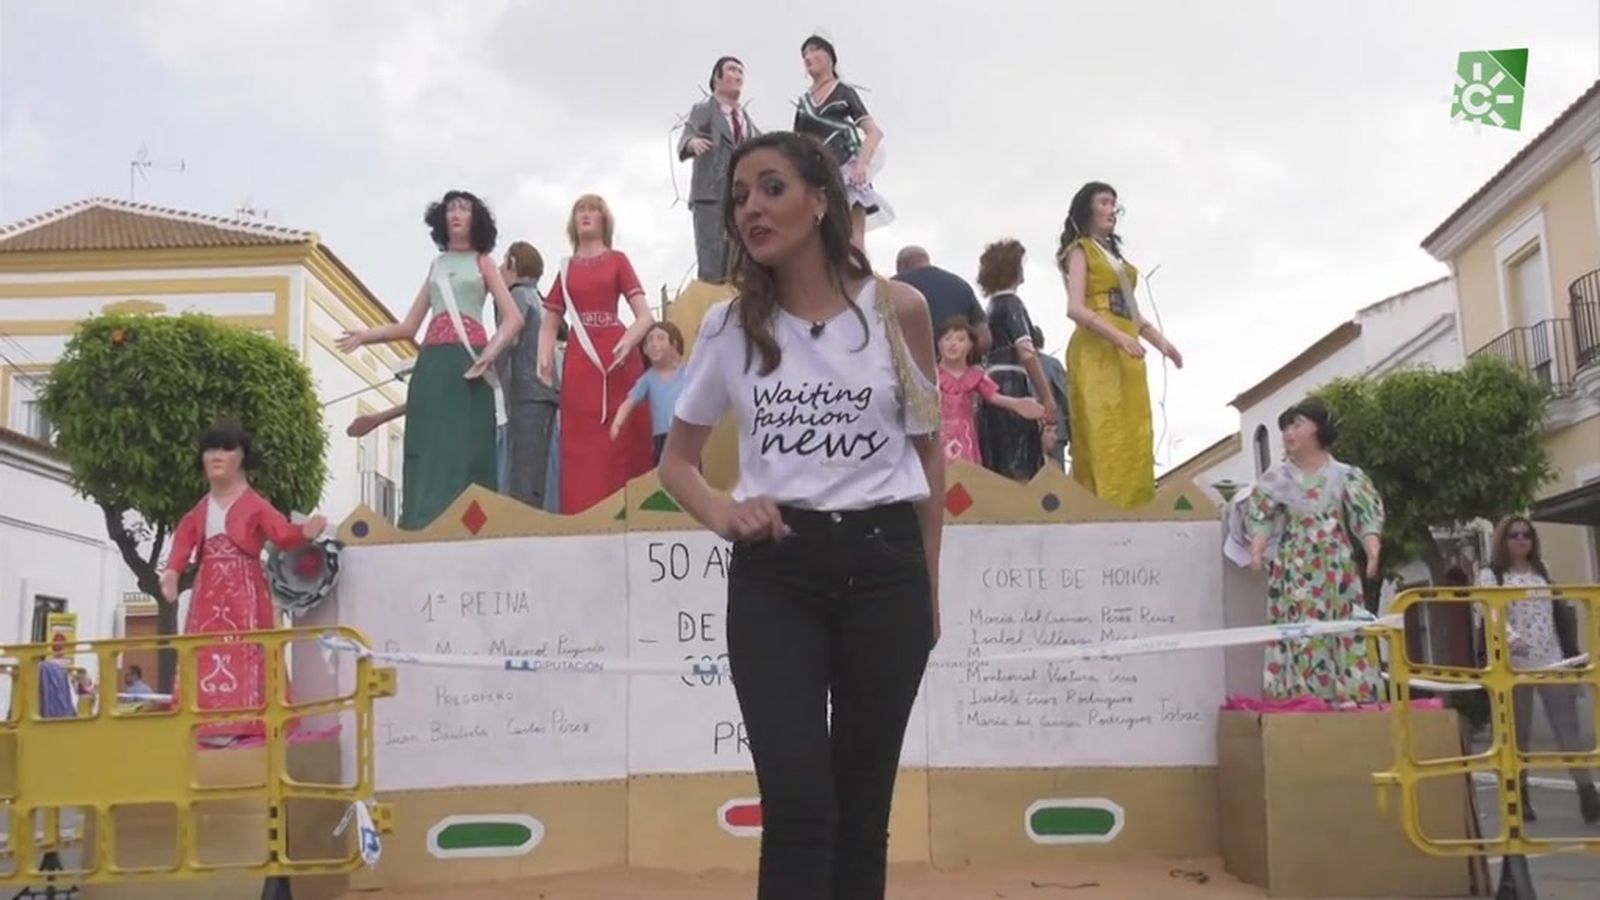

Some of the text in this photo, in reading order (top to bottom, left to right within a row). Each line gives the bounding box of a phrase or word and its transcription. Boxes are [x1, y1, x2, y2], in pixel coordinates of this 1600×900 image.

[753, 381, 873, 411] Waiting
[752, 405, 860, 436] fashion
[761, 428, 890, 461] news
[648, 542, 691, 583] 50
[982, 567, 1161, 590] CORTE DE HONOR
[460, 591, 530, 618] REINA
[678, 611, 716, 643] DE
